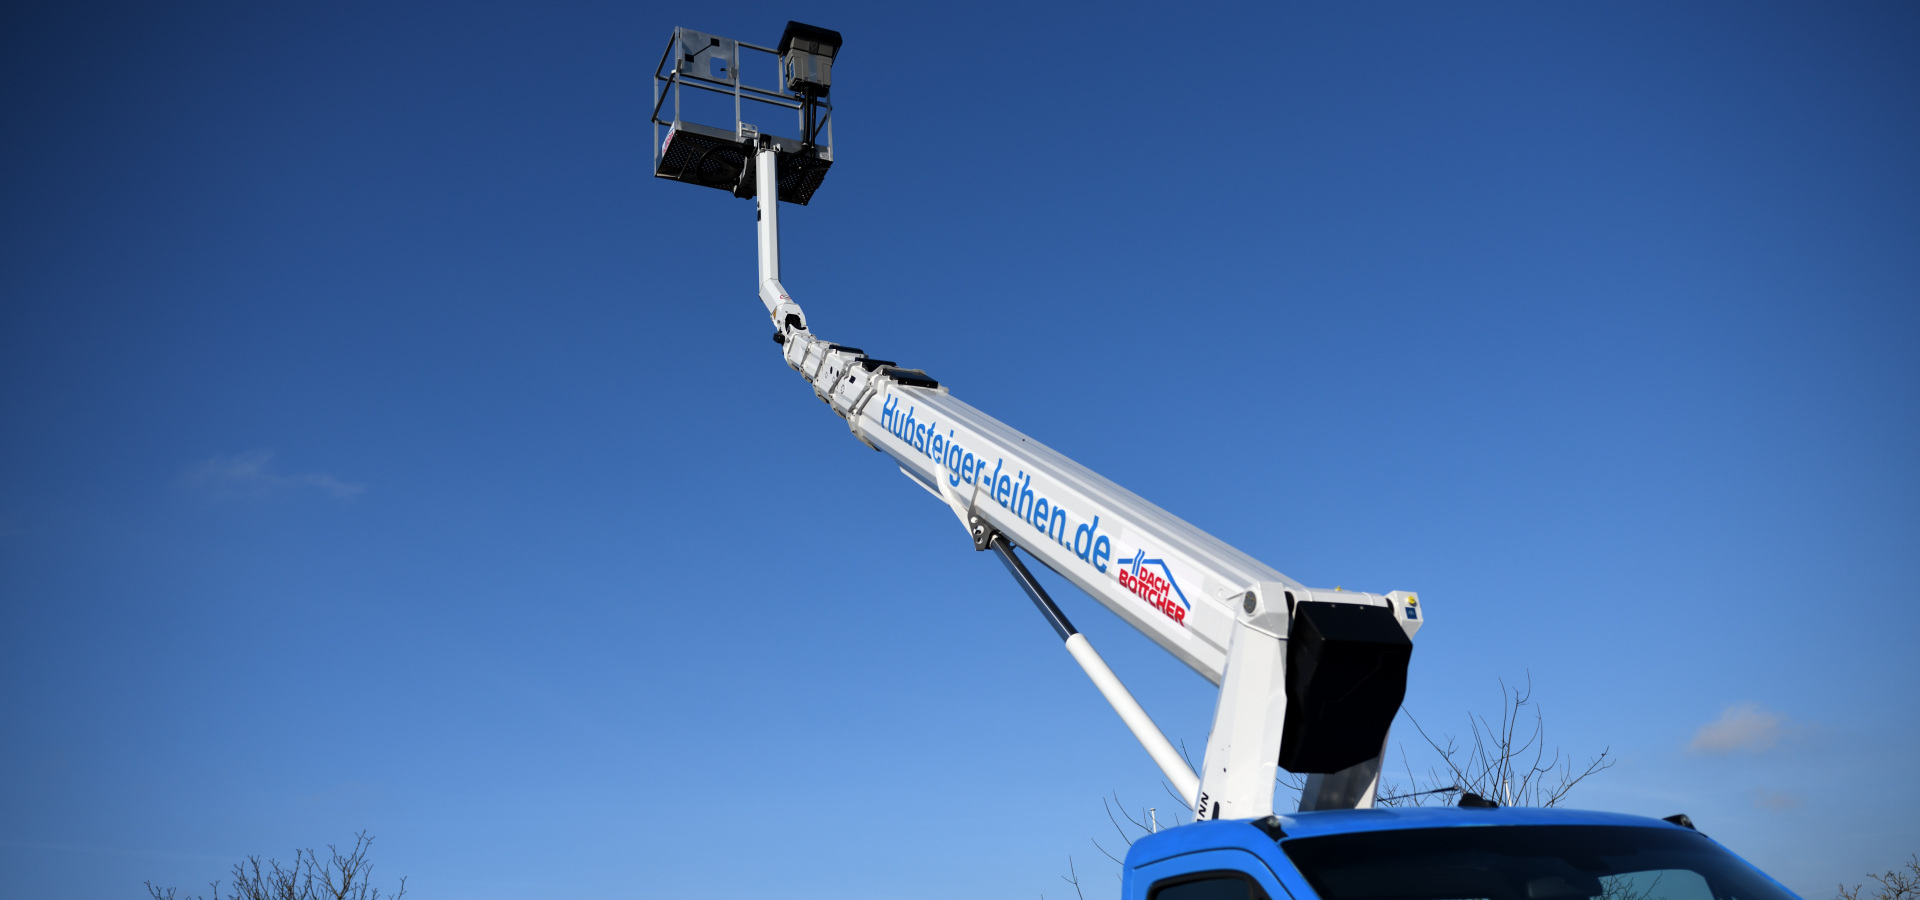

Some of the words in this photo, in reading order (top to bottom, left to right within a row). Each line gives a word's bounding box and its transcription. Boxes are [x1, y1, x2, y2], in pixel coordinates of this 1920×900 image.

[881, 393, 1111, 574] Hubsteiger-leihen.de
[1139, 566, 1170, 597] DACH
[1196, 791, 1209, 822] NN
